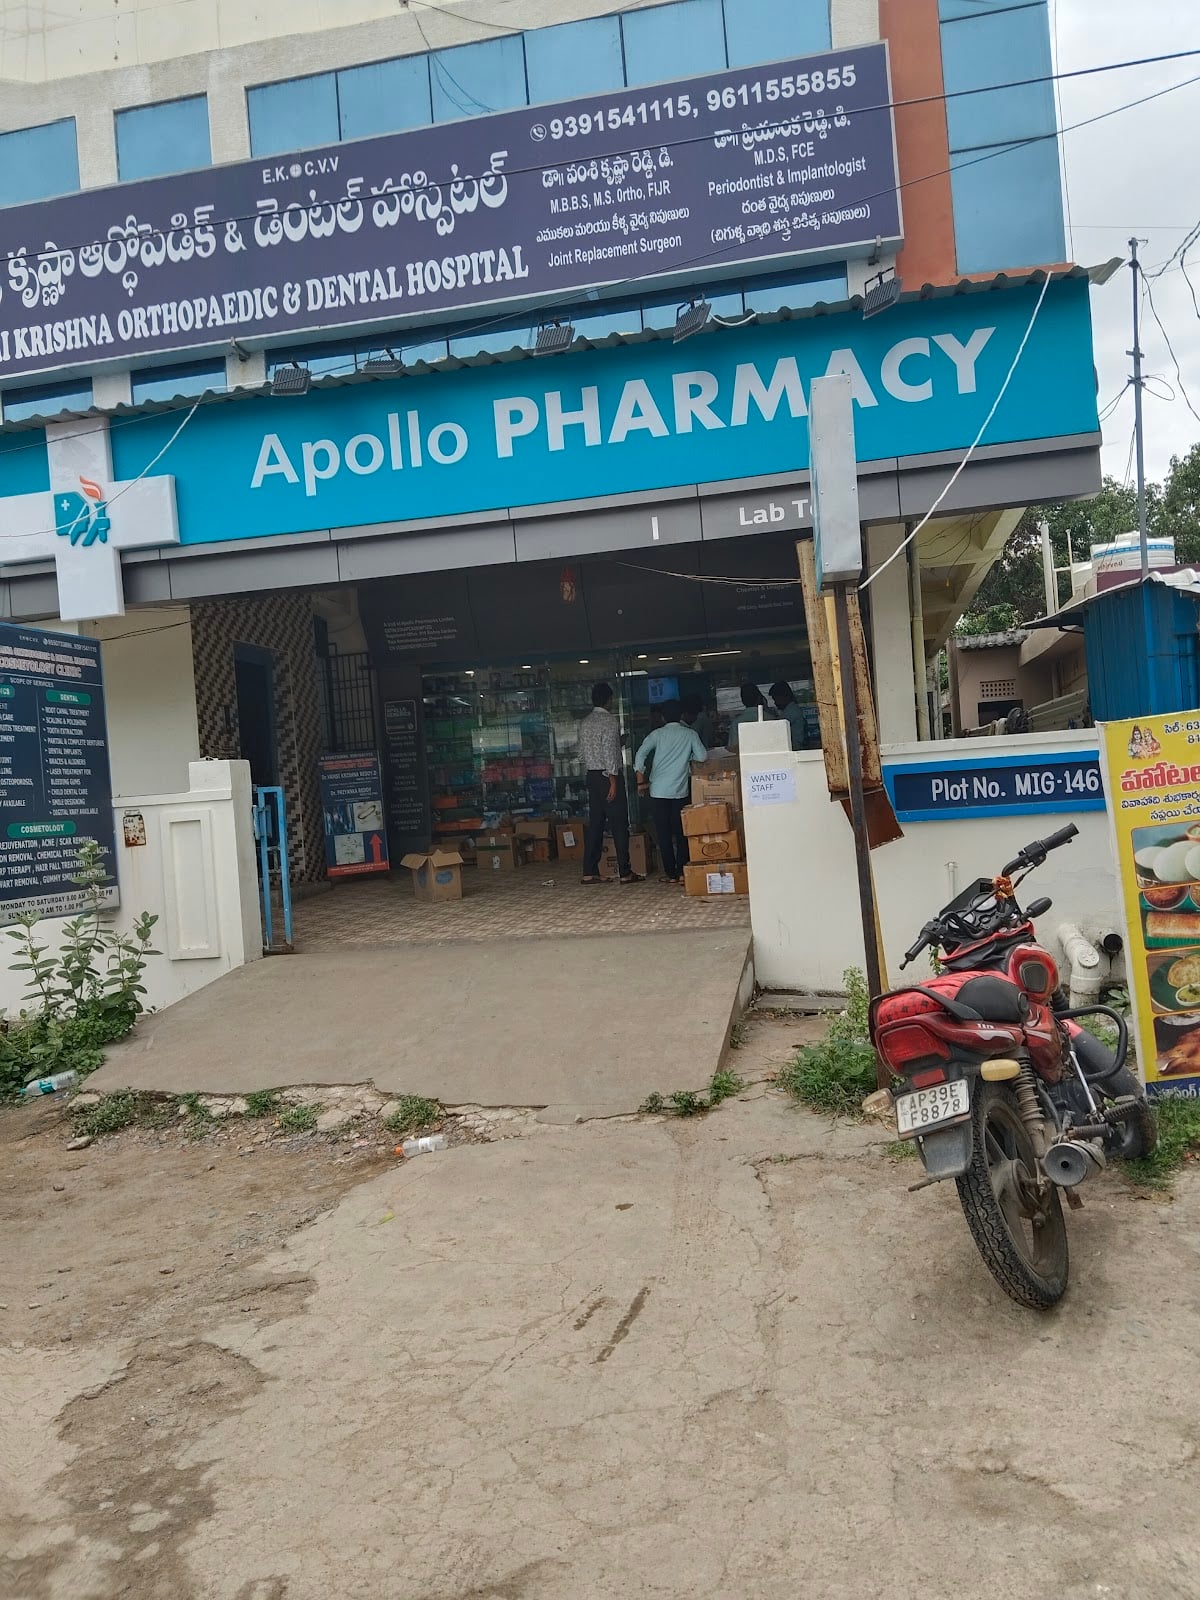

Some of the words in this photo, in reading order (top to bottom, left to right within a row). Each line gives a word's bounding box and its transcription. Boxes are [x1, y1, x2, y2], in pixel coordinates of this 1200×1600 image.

[550, 94, 699, 140] 9391541115,
[706, 64, 857, 111] 9611555855
[304, 156, 339, 177] C.V.V
[753, 147, 789, 166] M.D.S,
[791, 141, 815, 161] FCE
[707, 170, 775, 197] Periodontist
[776, 169, 786, 185] &
[787, 157, 867, 185] Implantologist
[550, 194, 592, 214] M.B.B.S,
[593, 188, 615, 207] M.S.
[647, 179, 672, 198] FIJR
[741, 197, 767, 214] దంత
[768, 194, 790, 214] వైద్య
[790, 188, 835, 207] నిపుణులు
[225, 219, 248, 254] &
[254, 177, 364, 248] డెంటల్
[536, 226, 574, 243] ఎముకలు
[575, 219, 611, 237] మరియు
[649, 207, 690, 225] నిపుణులు
[548, 251, 573, 268] Joint
[574, 242, 639, 264] Replacement
[640, 234, 682, 256] Surgeon
[0, 331, 11, 362] I
[14, 313, 114, 361] KRISHNA
[118, 283, 279, 341] ORTHOPAEDIC
[282, 281, 302, 316] &
[305, 268, 403, 313] DENTAL
[406, 245, 529, 297] HOSPITAL
[250, 411, 469, 498] Apollo
[494, 326, 996, 459] PHARMACY
[739, 502, 785, 526] Lab
[791, 498, 814, 519] T
[750, 772, 787, 783] WANTED
[751, 783, 774, 793] STAFF
[931, 777, 969, 801] Plot
[973, 775, 1006, 799] No.
[1015, 768, 1100, 796] MIG-146
[21, 823, 65, 834] COSMETOLOGY
[37, 850, 62, 860] CHEMICAL
[41, 838, 55, 847] ACNE
[59, 837, 72, 846] SCAR
[35, 863, 48, 873] HAIR
[49, 862, 61, 871] FALL
[43, 874, 61, 884] GUMMY
[0, 901, 26, 911] MONDAY
[36, 896, 65, 906] SATURDAY
[910, 1083, 959, 1109] AP39E
[910, 1098, 961, 1128] F8878
